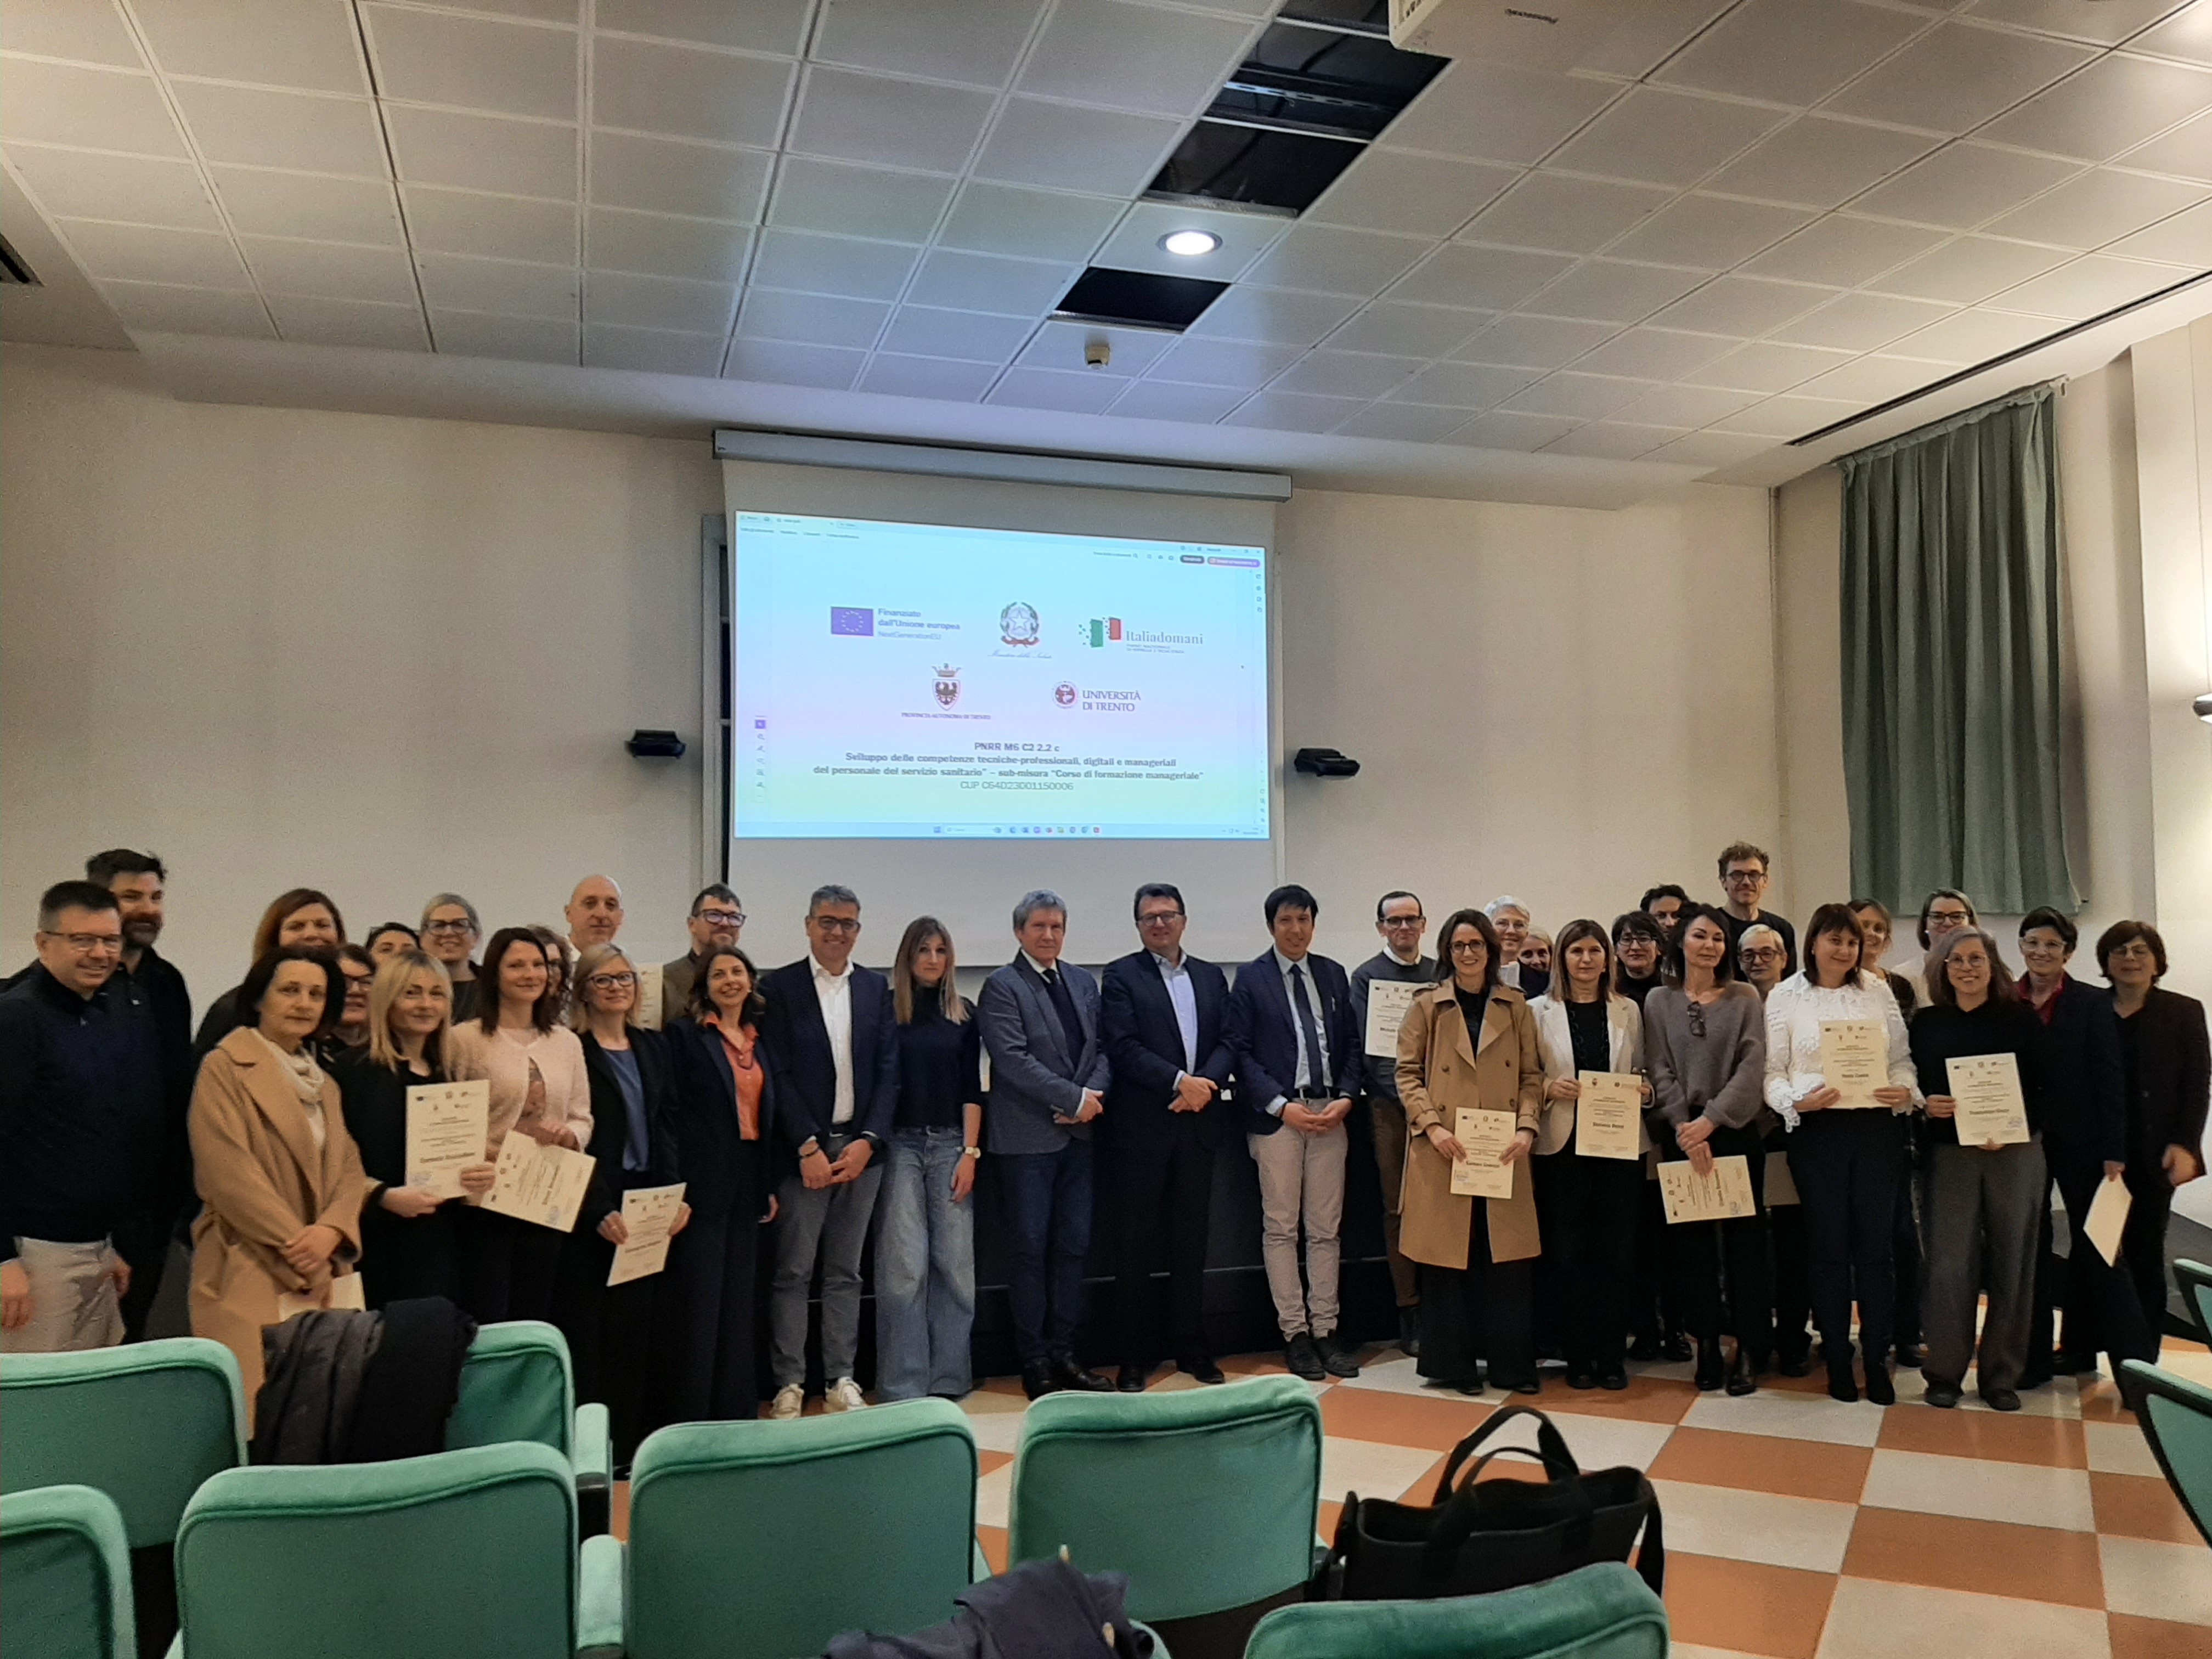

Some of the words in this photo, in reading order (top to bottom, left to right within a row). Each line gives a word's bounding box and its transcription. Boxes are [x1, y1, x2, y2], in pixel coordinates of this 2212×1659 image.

[878, 608, 921, 617] Finanziato
[927, 622, 961, 630] europea
[1126, 631, 1203, 644] Italiadomani
[1082, 690, 1141, 700] UNIVERSITÀ
[1095, 702, 1135, 711] TRENTO
[974, 742, 1001, 751] PNRR
[1004, 743, 1019, 751] M6
[845, 753, 888, 763] Sviluppo
[890, 754, 915, 762] delle
[917, 755, 975, 764] competenze
[1083, 758, 1114, 767] digitali
[1125, 759, 1176, 768] manageriali
[832, 766, 881, 775] personale
[1084, 770, 1092, 778] di
[1094, 770, 1144, 779] formazione
[960, 781, 979, 789] CUP
